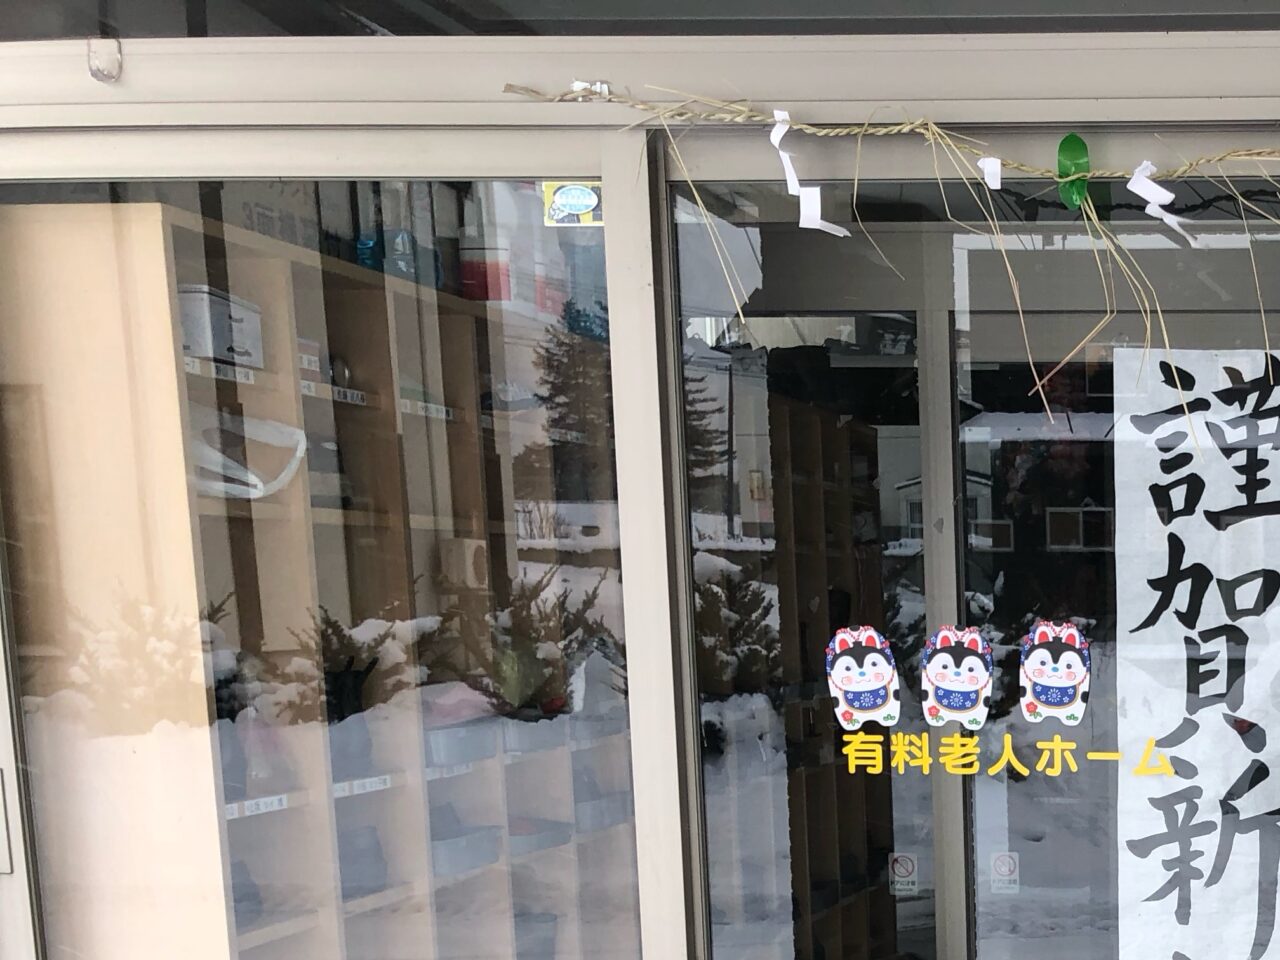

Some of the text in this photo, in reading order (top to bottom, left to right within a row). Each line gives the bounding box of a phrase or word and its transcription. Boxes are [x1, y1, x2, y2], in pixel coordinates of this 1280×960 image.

[842, 732, 1175, 776] 有料老人ホーム
